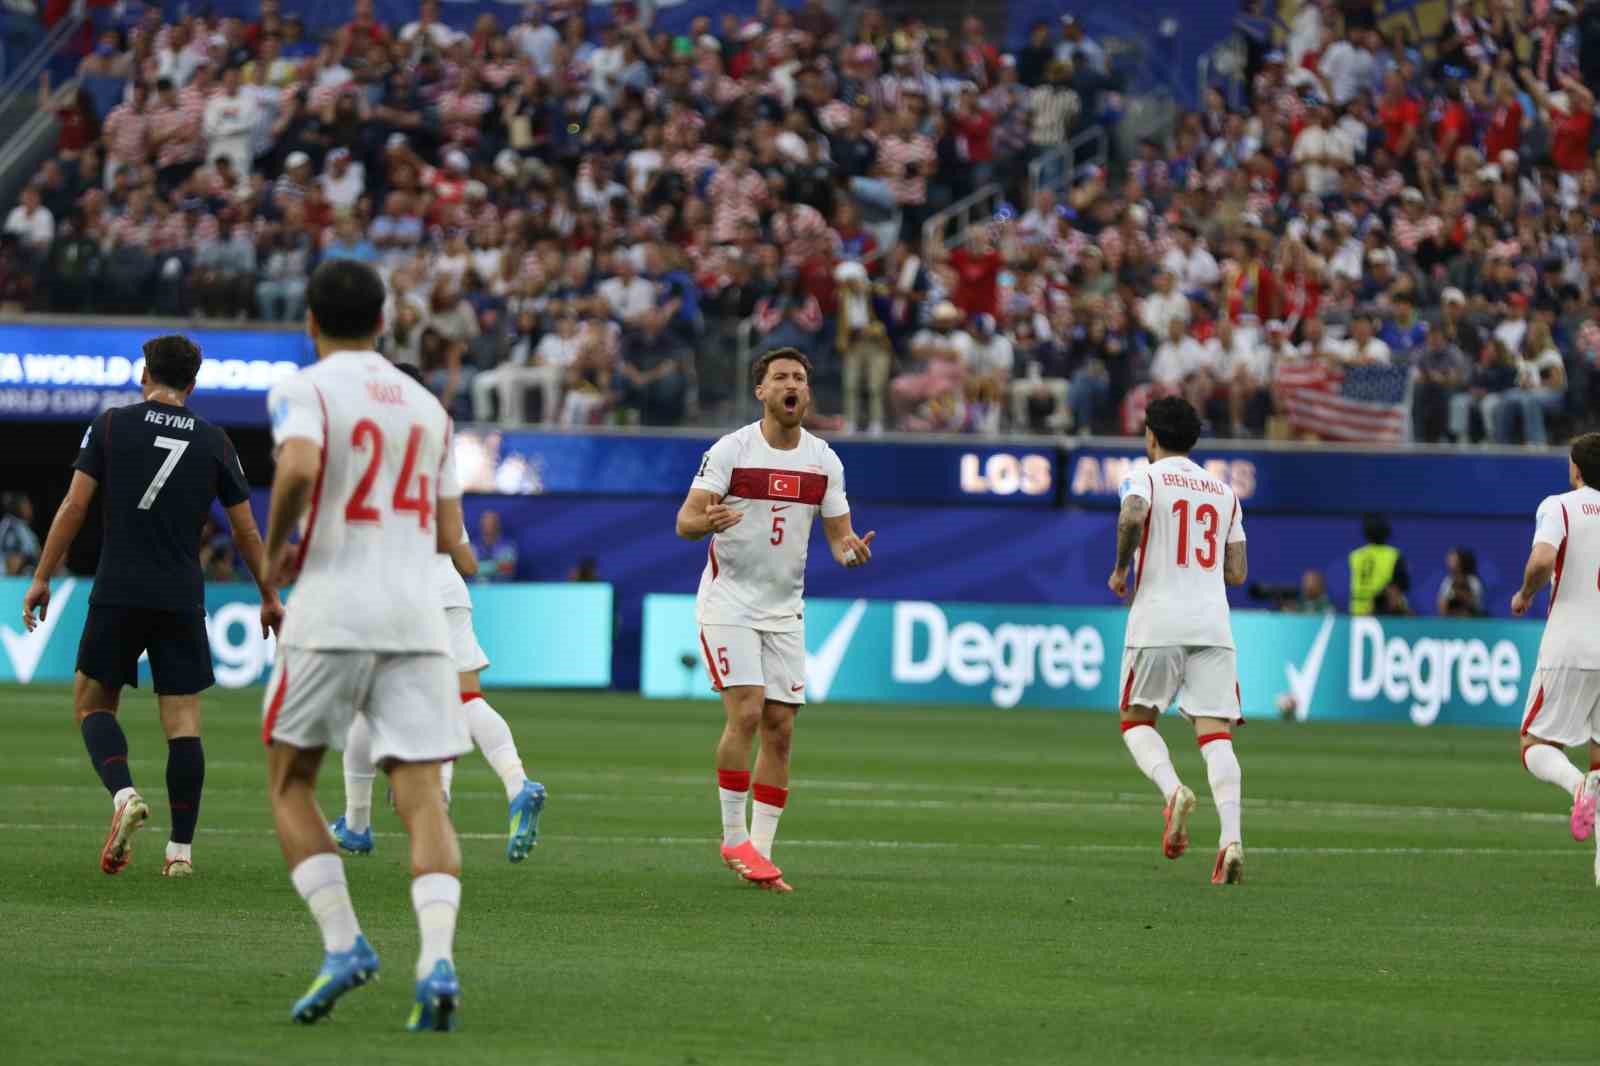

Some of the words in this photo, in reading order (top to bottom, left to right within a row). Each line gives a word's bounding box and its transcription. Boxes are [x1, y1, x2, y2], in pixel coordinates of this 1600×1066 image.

[24, 353, 131, 386] WORLD
[144, 409, 196, 431] REYNA
[137, 436, 190, 510] 7
[345, 417, 432, 532] 24
[960, 454, 1051, 495] LOS
[1162, 473, 1188, 488] EREN
[770, 517, 784, 545] 5
[1172, 499, 1218, 568] 13
[717, 647, 729, 676] 5
[892, 600, 1104, 708] Degree
[1349, 616, 1521, 726] Degree
